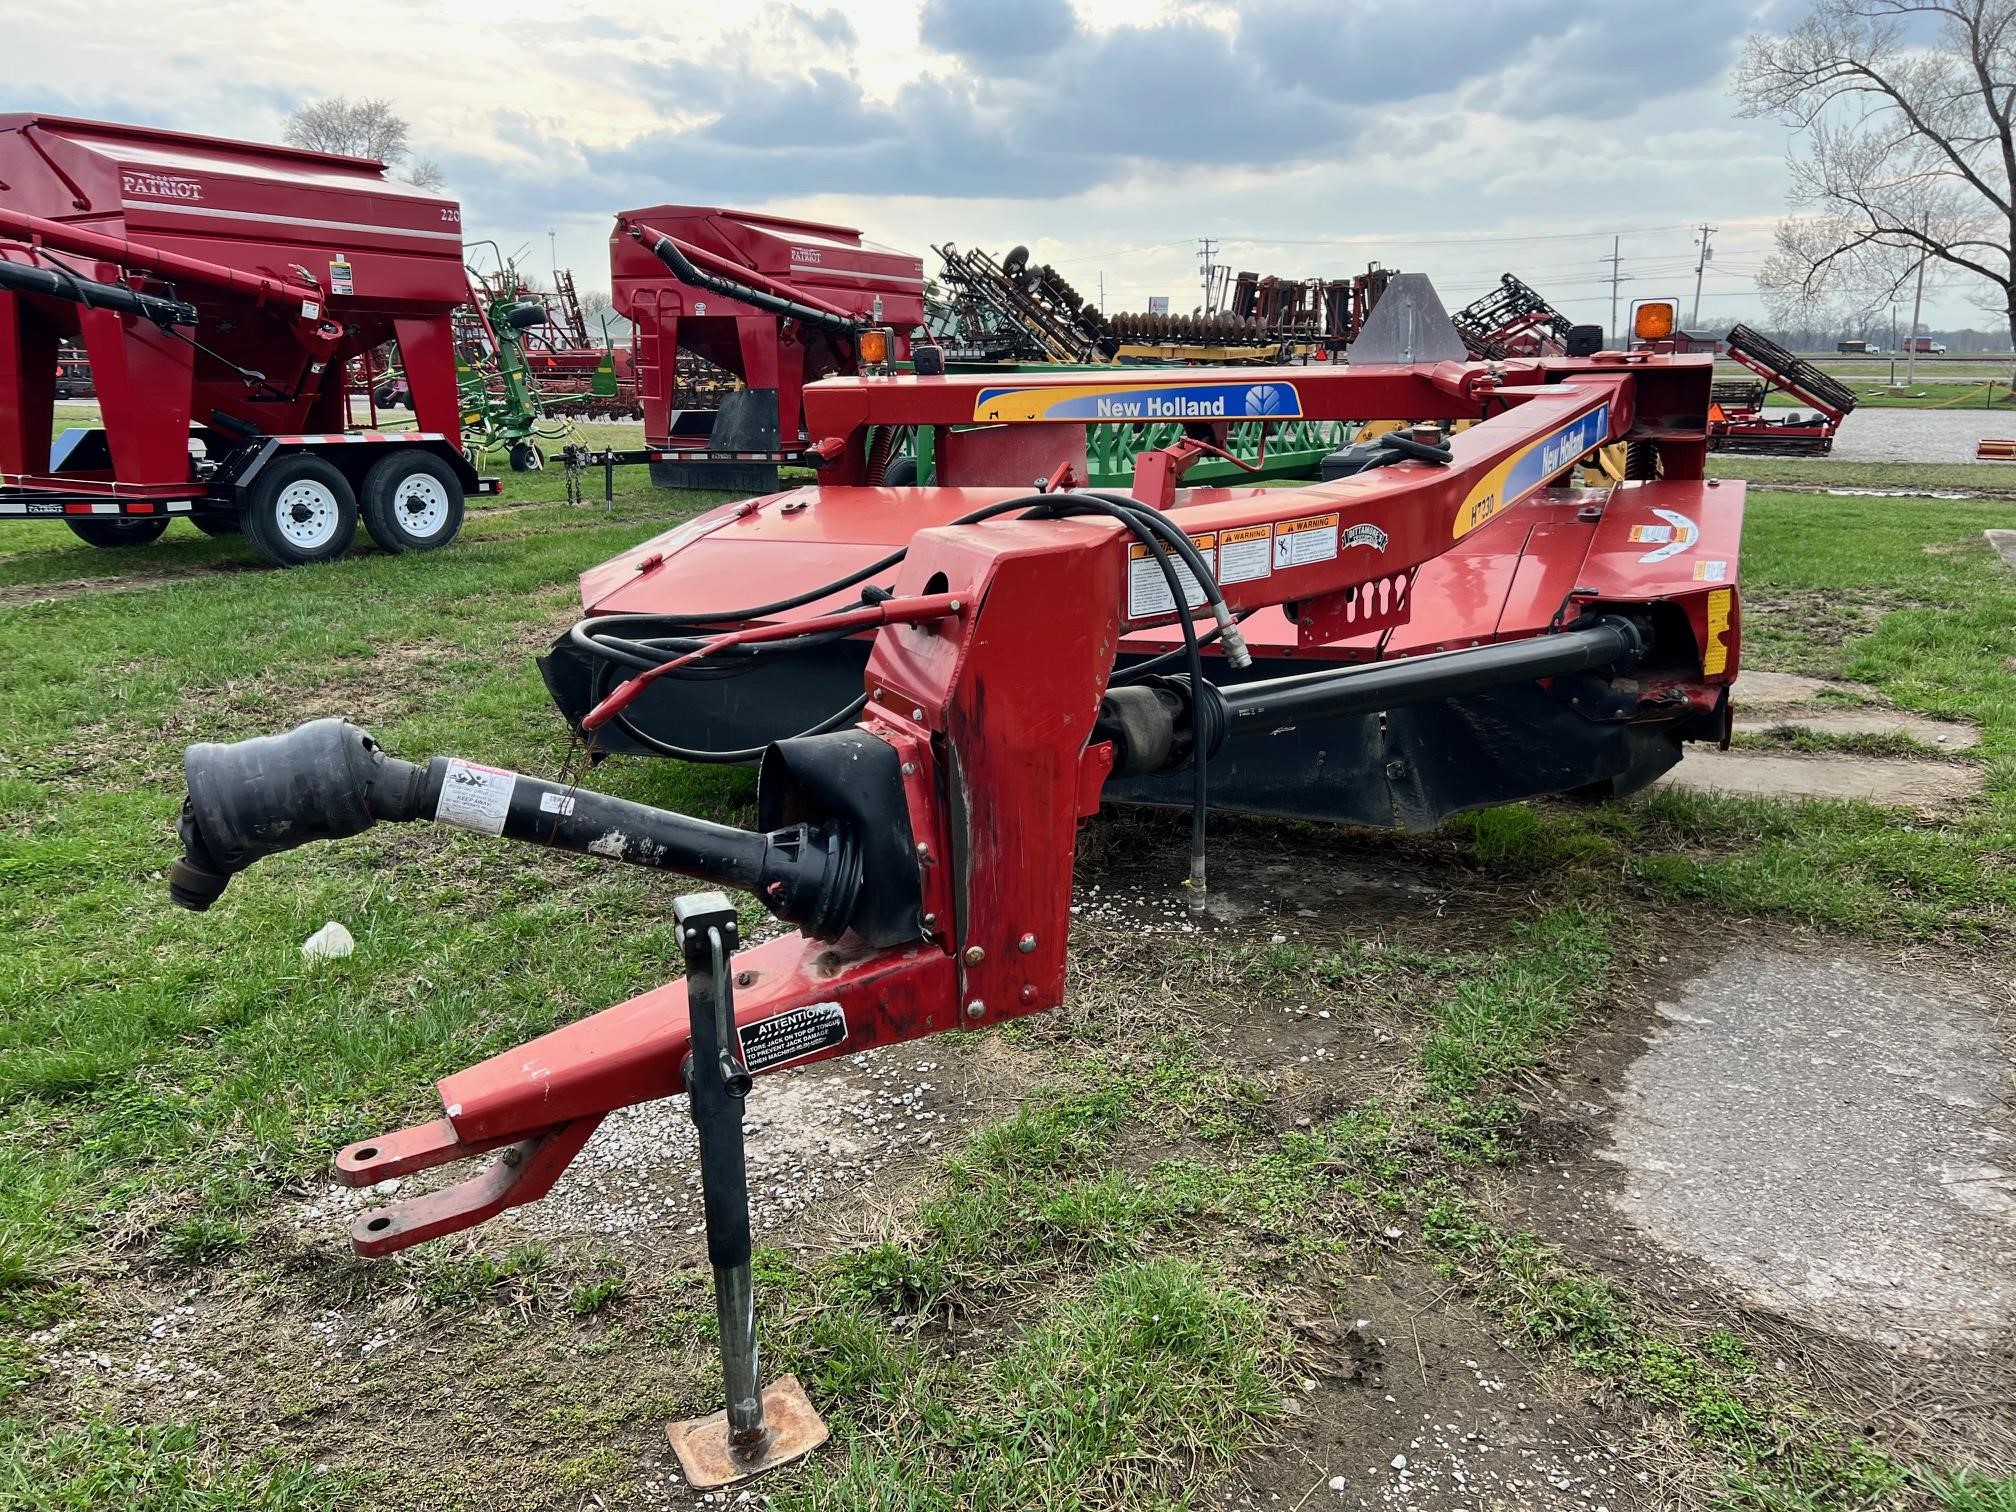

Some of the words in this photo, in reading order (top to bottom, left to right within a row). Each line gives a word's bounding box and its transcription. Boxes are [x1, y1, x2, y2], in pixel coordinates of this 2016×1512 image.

[122, 176, 203, 199] PATRIOT
[441, 208, 460, 222] 220
[791, 250, 821, 263] PATRIOT
[1097, 398, 1140, 416] New
[1147, 396, 1225, 416] Holland
[1542, 445, 1560, 478] New
[1560, 424, 1585, 466] Holland
[1296, 517, 1329, 530] WARNING
[1233, 529, 1266, 541] WARNING
[456, 795, 473, 803] KEEP
[474, 798, 490, 807] AWAY
[758, 1008, 825, 1035] ATTENTION
[745, 1042, 767, 1054] STORE
[767, 1037, 784, 1047] JACK
[784, 1033, 794, 1041] ON
[794, 1029, 806, 1038] TOP
[806, 1026, 816, 1034] OF
[816, 1018, 841, 1030] TONGUE
[757, 1043, 785, 1057] PREVENT
[785, 1037, 803, 1048] JACK
[803, 1028, 829, 1042] DAMAGE
[748, 1056, 768, 1067] WHEN
